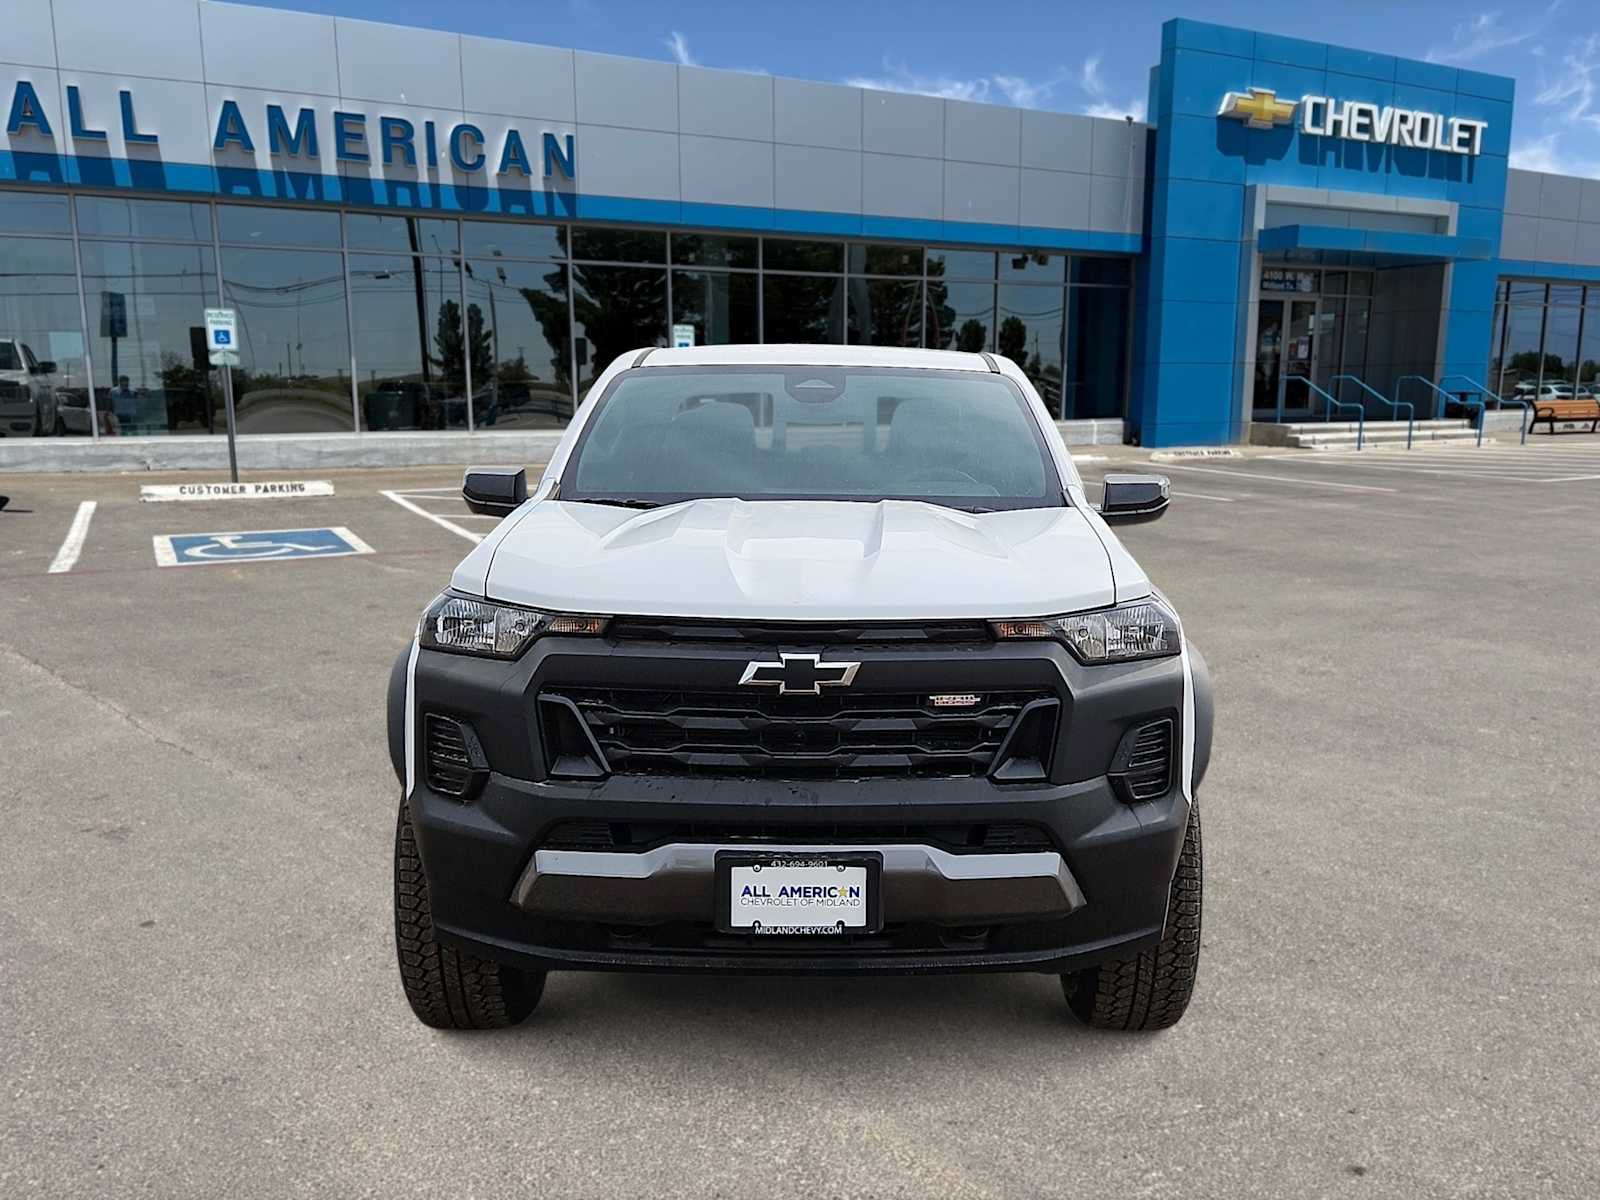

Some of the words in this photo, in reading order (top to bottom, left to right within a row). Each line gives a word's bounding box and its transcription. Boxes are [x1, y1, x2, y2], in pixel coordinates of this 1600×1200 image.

[8, 81, 158, 143] ALL
[213, 99, 576, 178] AMERICAN
[1302, 94, 1489, 155] CHEVROLET
[179, 485, 246, 495] CUSTOMER
[254, 483, 306, 493] PARKING
[770, 860, 828, 868] 432-694-9601
[741, 885, 771, 898] ALL
[740, 898, 797, 907] CHEVROLET
[801, 898, 814, 906] OF
[816, 898, 861, 907] MIDLAND
[755, 926, 843, 935] MIDLANDCHEVY.COM
